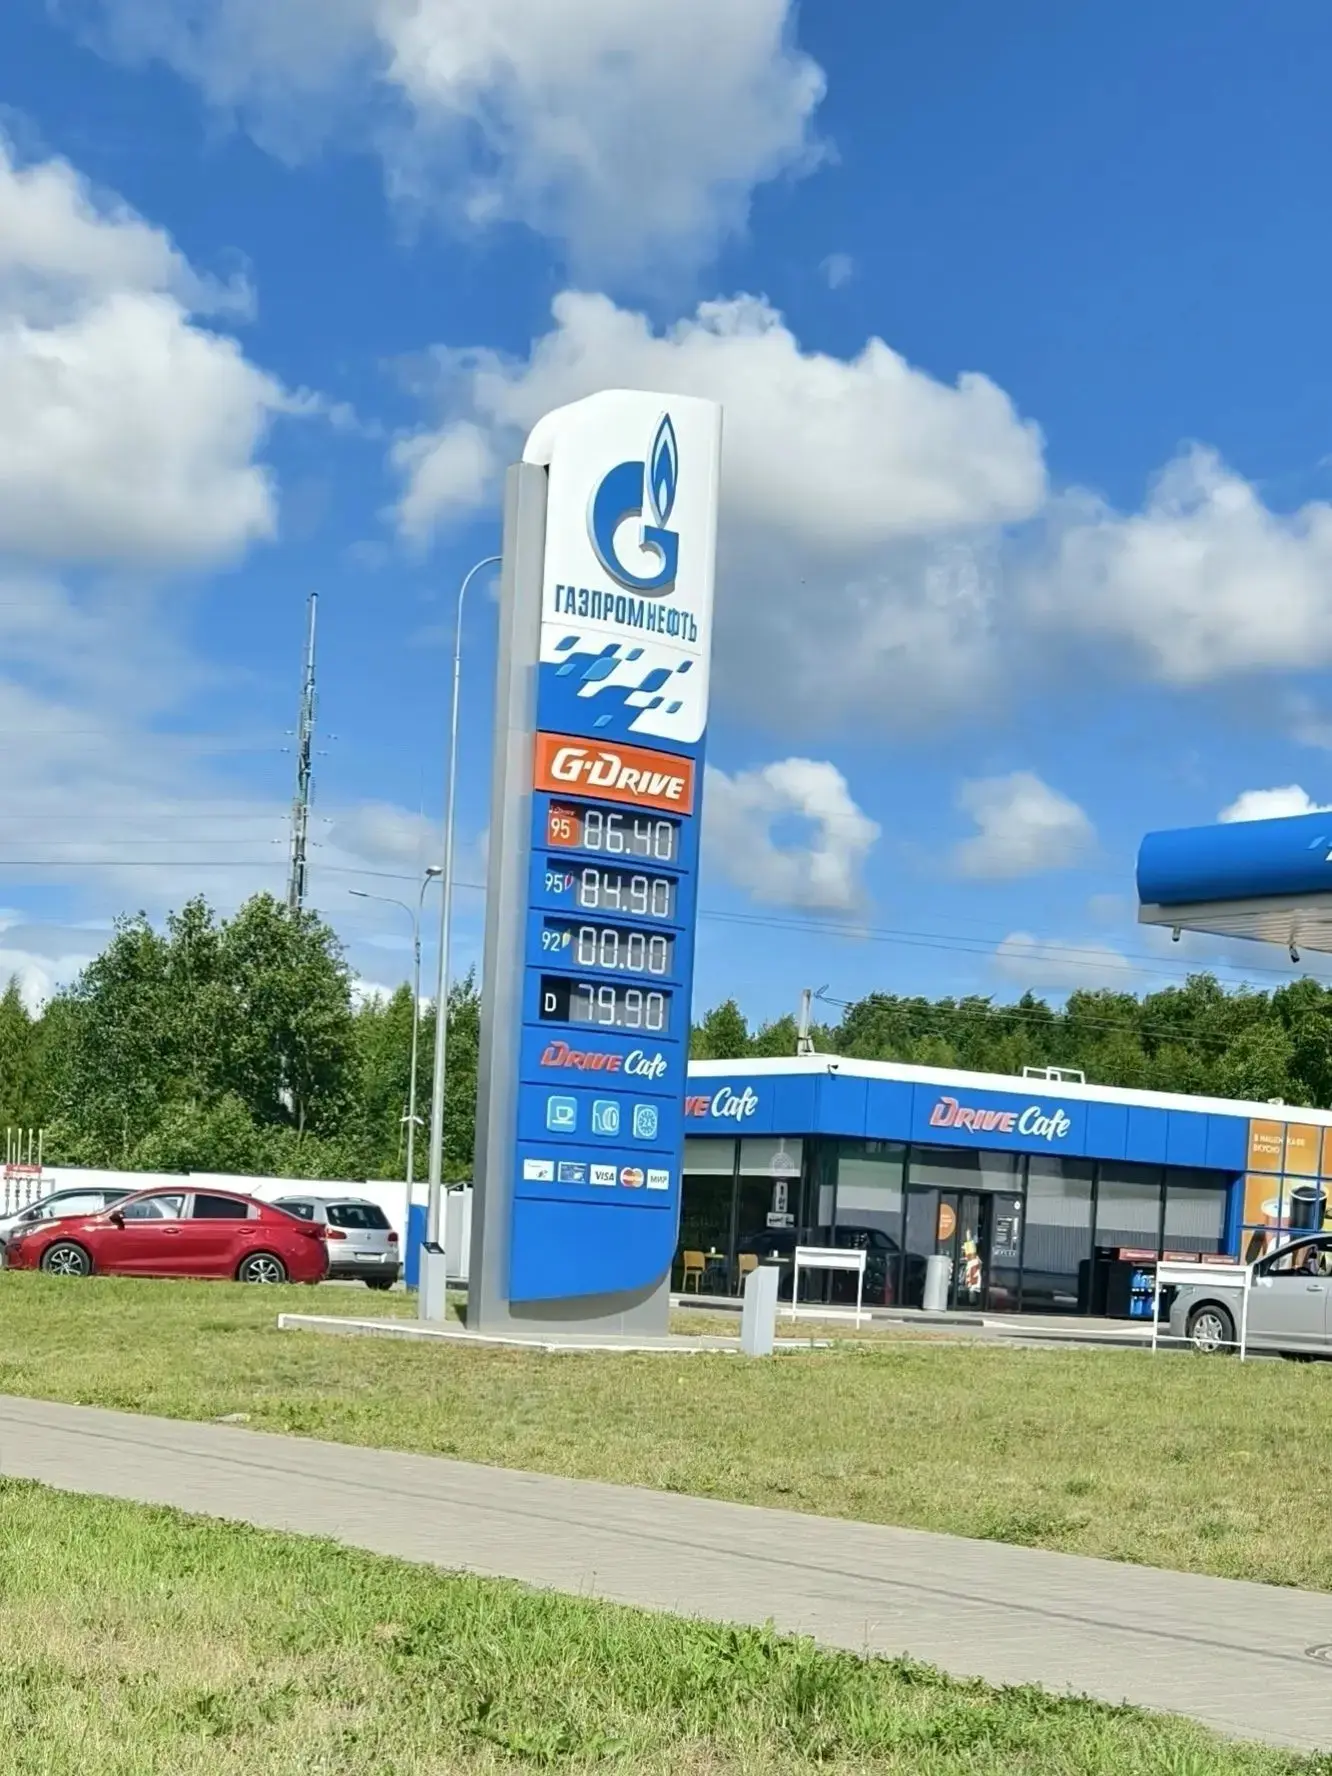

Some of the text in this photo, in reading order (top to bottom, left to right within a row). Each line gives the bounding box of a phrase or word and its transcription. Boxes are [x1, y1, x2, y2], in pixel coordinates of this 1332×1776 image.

[554, 584, 698, 643] ГАЗПРОМНЕФТЬ
[551, 810, 673, 860] 95 86.40
[545, 868, 669, 917] 95 84.90
[542, 926, 667, 974] 92 00.00
[544, 983, 664, 1030] D 79.90
[624, 1050, 668, 1080] Cafe
[711, 1086, 759, 1122] Cafe
[1017, 1105, 1071, 1141] Cafe
[595, 1171, 615, 1182] VISA
